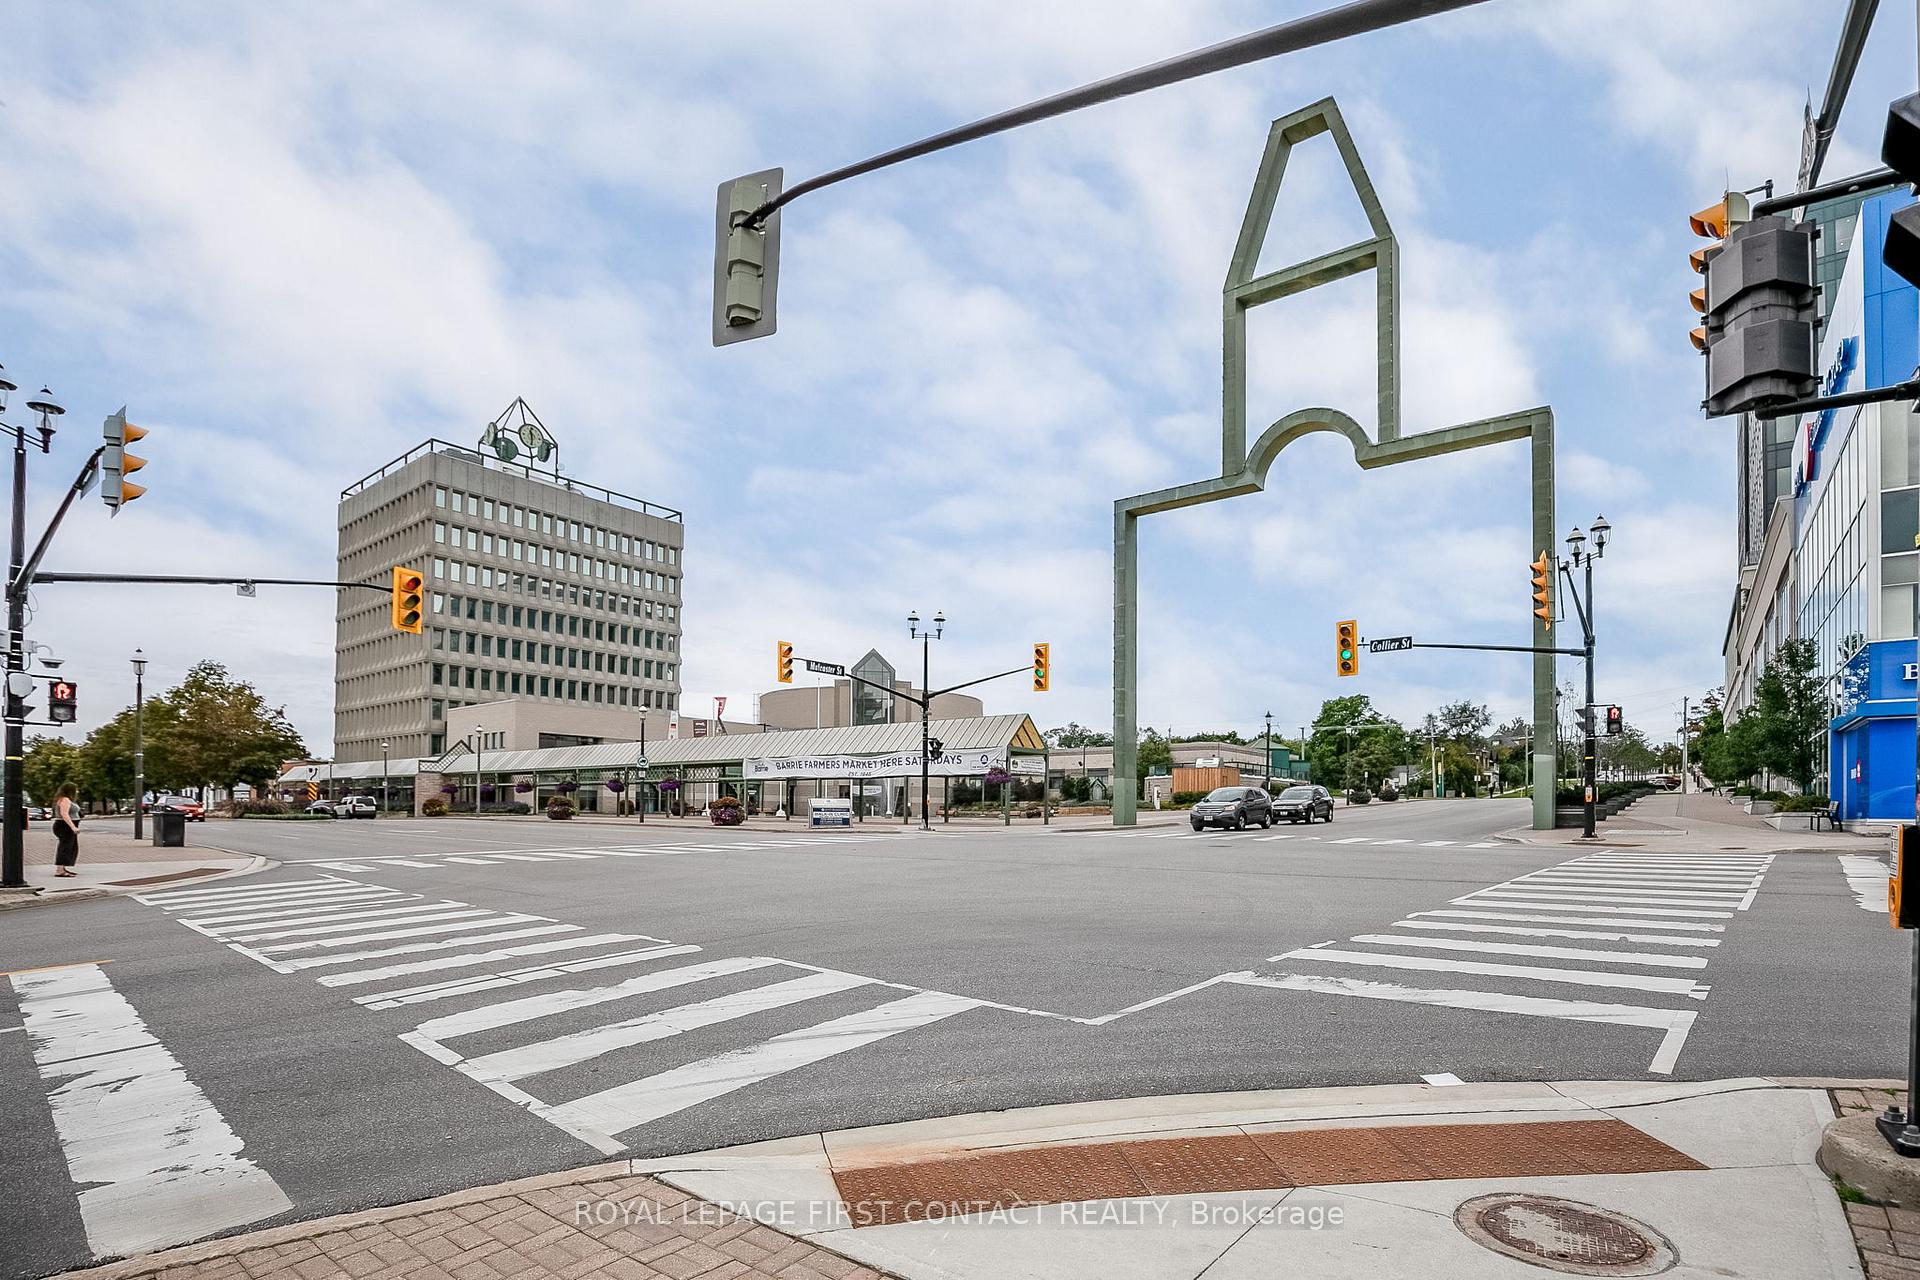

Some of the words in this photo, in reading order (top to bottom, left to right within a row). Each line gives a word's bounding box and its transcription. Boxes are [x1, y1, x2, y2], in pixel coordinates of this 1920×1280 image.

[1371, 640, 1399, 651] Collier
[1401, 638, 1411, 649] St
[810, 661, 835, 674] Mulcaster
[836, 665, 843, 675] St
[775, 760, 803, 770] BARRIE
[804, 760, 840, 770] FARMERS
[842, 760, 878, 770] MARKET
[880, 756, 903, 768] HERE
[905, 755, 962, 766] SATRDAYS
